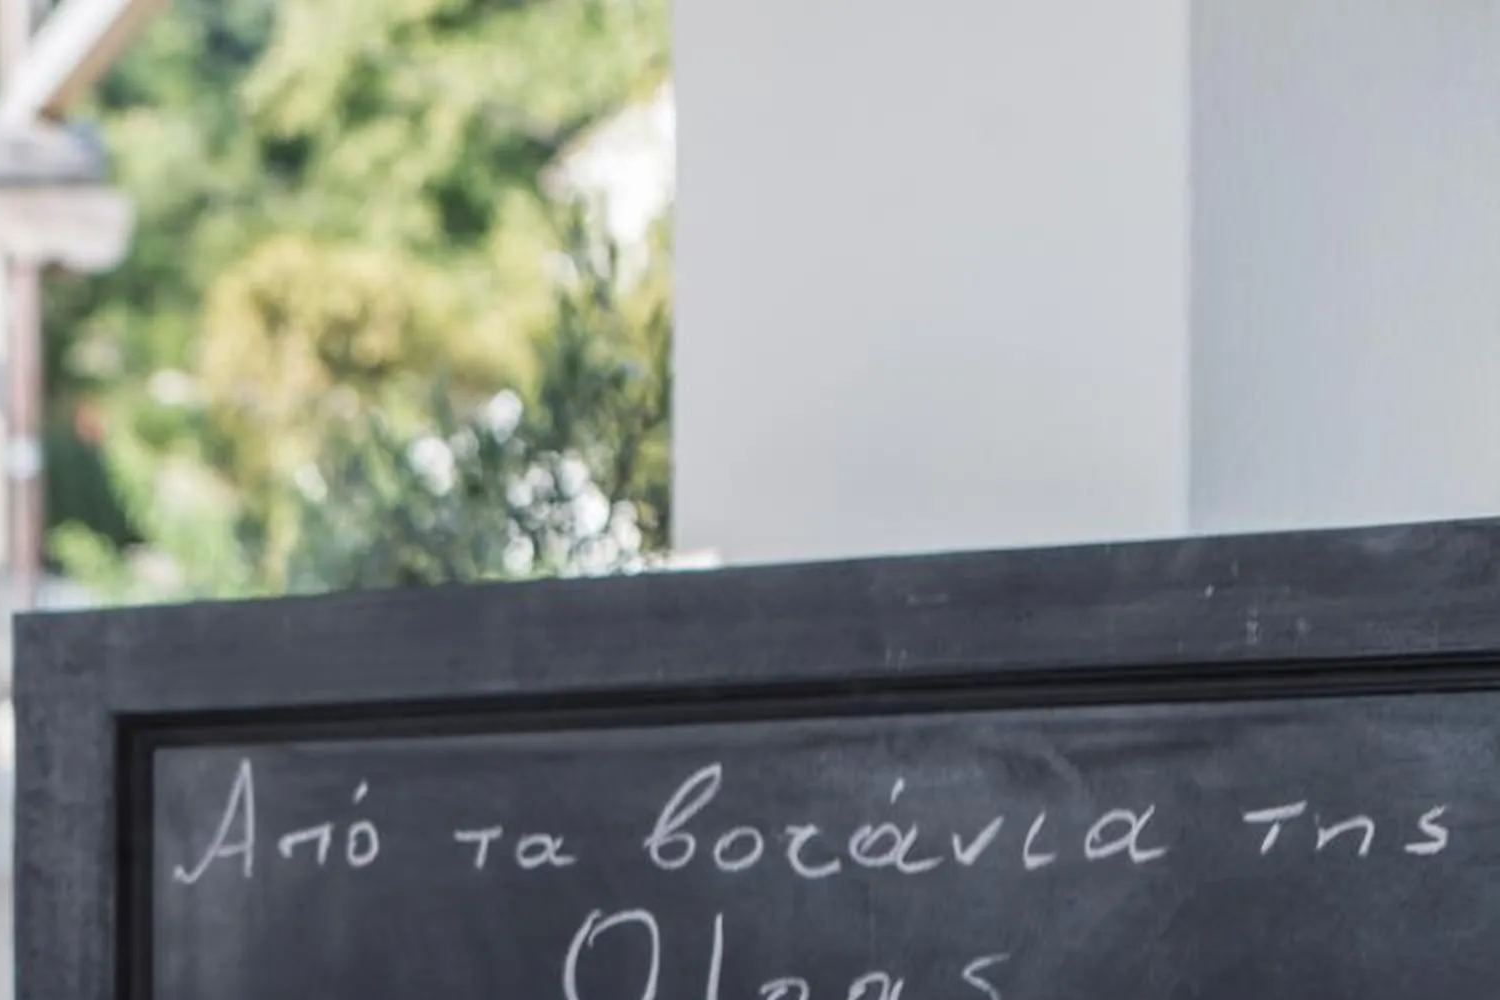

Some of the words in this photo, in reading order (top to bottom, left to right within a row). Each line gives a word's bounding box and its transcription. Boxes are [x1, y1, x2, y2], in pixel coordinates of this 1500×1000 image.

[170, 756, 382, 886] Από
[452, 824, 577, 871] τα
[642, 761, 1169, 880] βοτάνια
[1241, 799, 1452, 857] της
